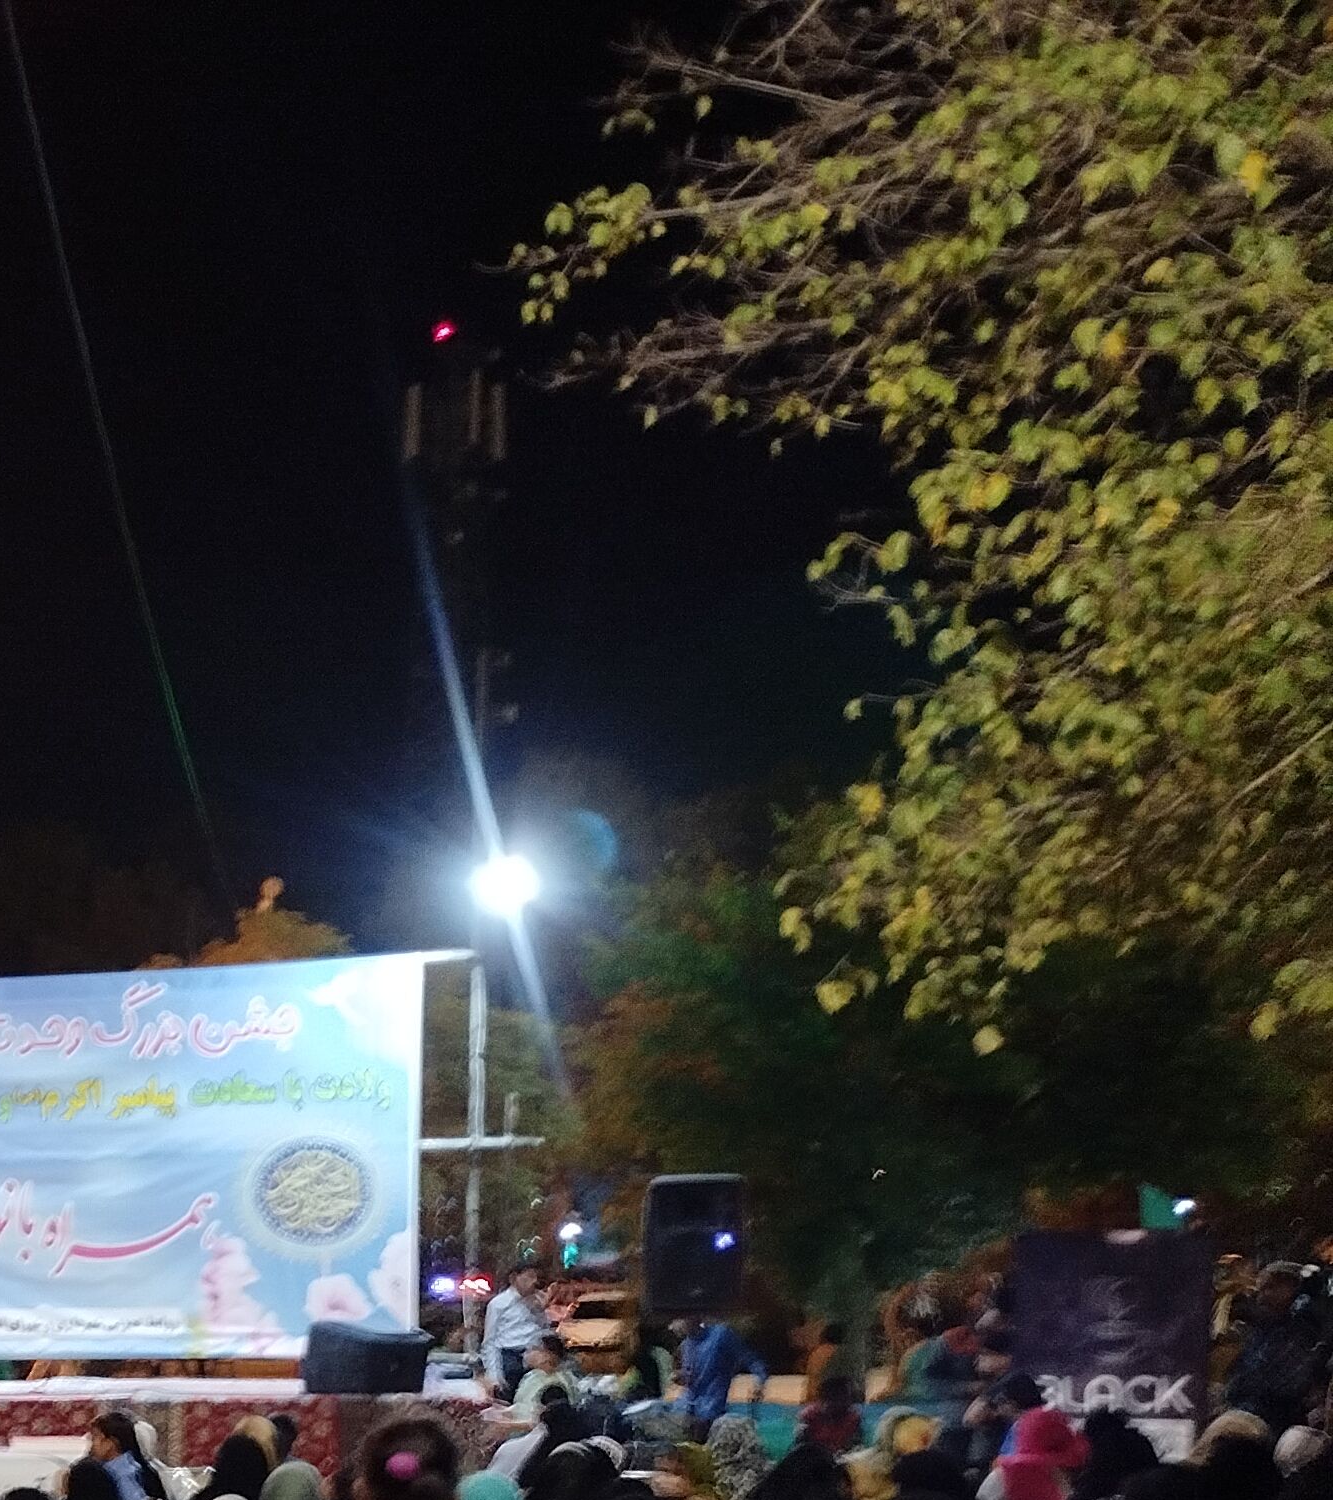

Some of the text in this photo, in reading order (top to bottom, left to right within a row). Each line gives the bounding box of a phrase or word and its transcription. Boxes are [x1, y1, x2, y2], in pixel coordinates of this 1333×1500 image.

[91, 981, 183, 1059] بزرگ
[190, 997, 300, 1056] جشن
[42, 1077, 103, 1121] اکرم
[106, 1074, 177, 1119] پیامبر
[189, 1070, 278, 1107] سعادت
[284, 1068, 304, 1111] با
[311, 1067, 392, 1111] ولادت
[44, 1192, 220, 1277] همراه
